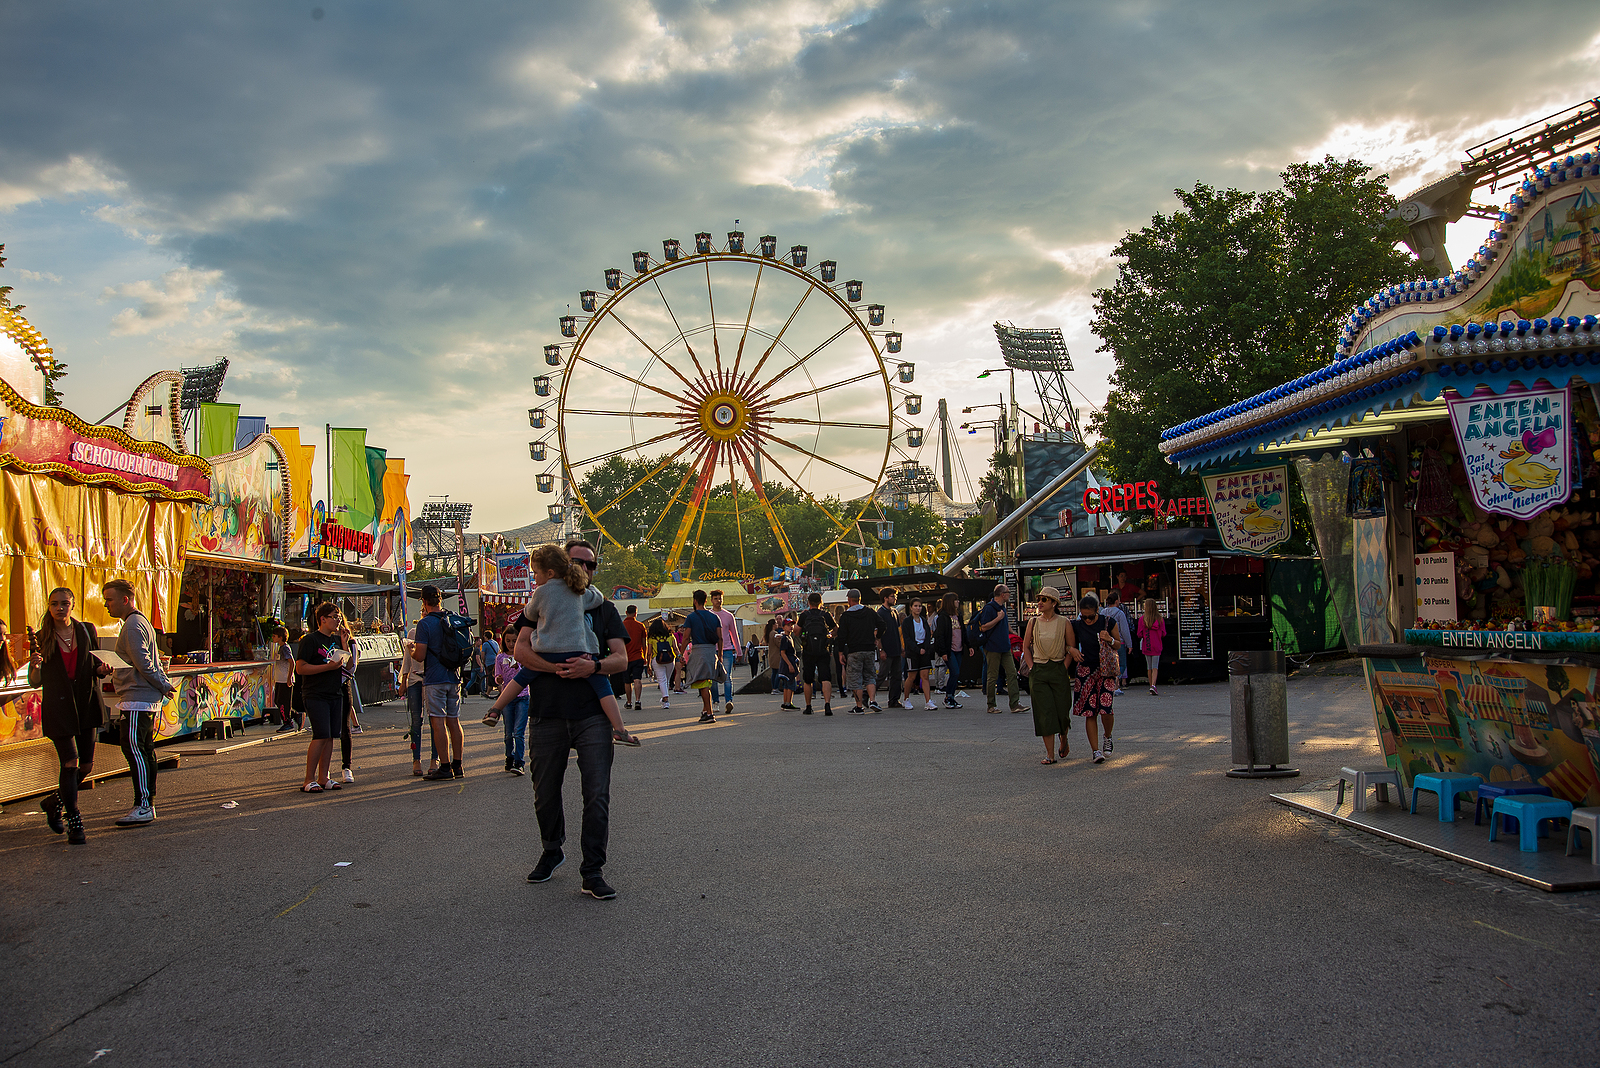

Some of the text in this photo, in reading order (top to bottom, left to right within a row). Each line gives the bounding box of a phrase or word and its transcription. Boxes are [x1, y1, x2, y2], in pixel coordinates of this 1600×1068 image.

[1468, 397, 1560, 423] ENTEN-
[1464, 414, 1562, 441] ANGELN
[73, 441, 179, 481] SCHOKOFRÜCHTE
[1466, 454, 1485, 465] Das
[1216, 471, 1282, 491] ENTEN-
[1083, 480, 1158, 514] CREPES
[1214, 483, 1284, 503] ANGELN
[1487, 491, 1514, 506] ohne
[1216, 511, 1230, 520] Das
[1231, 535, 1252, 547] ohne
[500, 569, 528, 579] Western
[698, 568, 755, 581] Willenborg
[1431, 577, 1449, 585] Punkte
[503, 579, 526, 590] Saloon
[1442, 631, 1542, 650] ENTEN ANGELN
